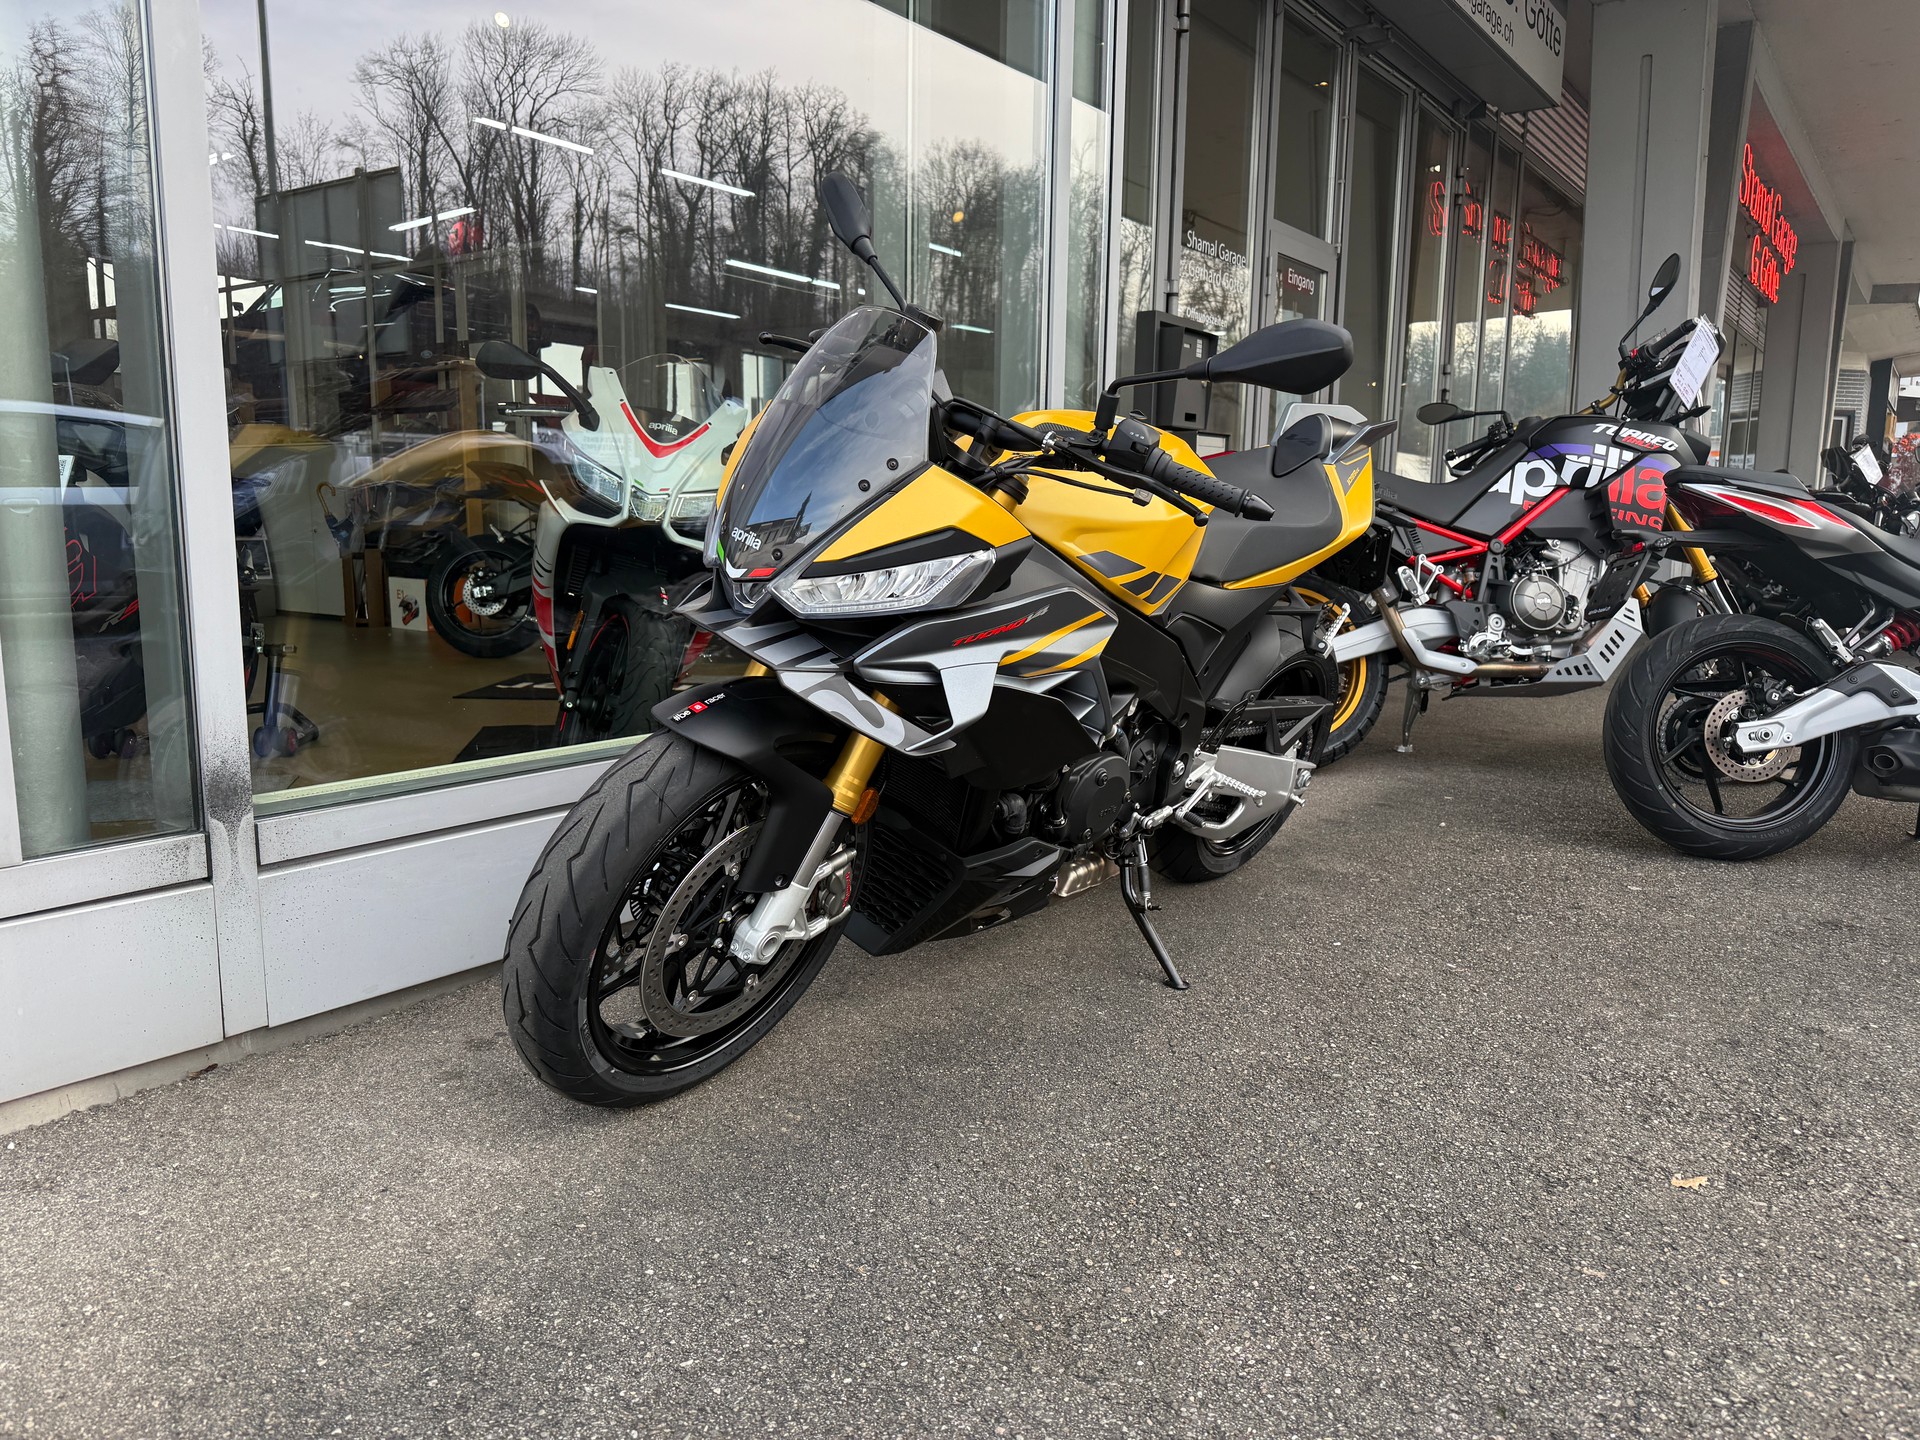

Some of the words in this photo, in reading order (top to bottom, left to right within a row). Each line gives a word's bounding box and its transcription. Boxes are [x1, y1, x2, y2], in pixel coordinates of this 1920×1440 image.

[1466, 0, 1514, 47] garage.ch
[1186, 229, 1218, 258] Shamal
[1218, 243, 1247, 268] Garage
[1188, 260, 1222, 287] Gerhard
[1287, 267, 1315, 295] Eingang
[648, 422, 679, 436] aprilia
[731, 526, 762, 550] aprilia
[952, 616, 1028, 647] TUONO
[672, 709, 691, 722] #be
[704, 692, 726, 705] racer
